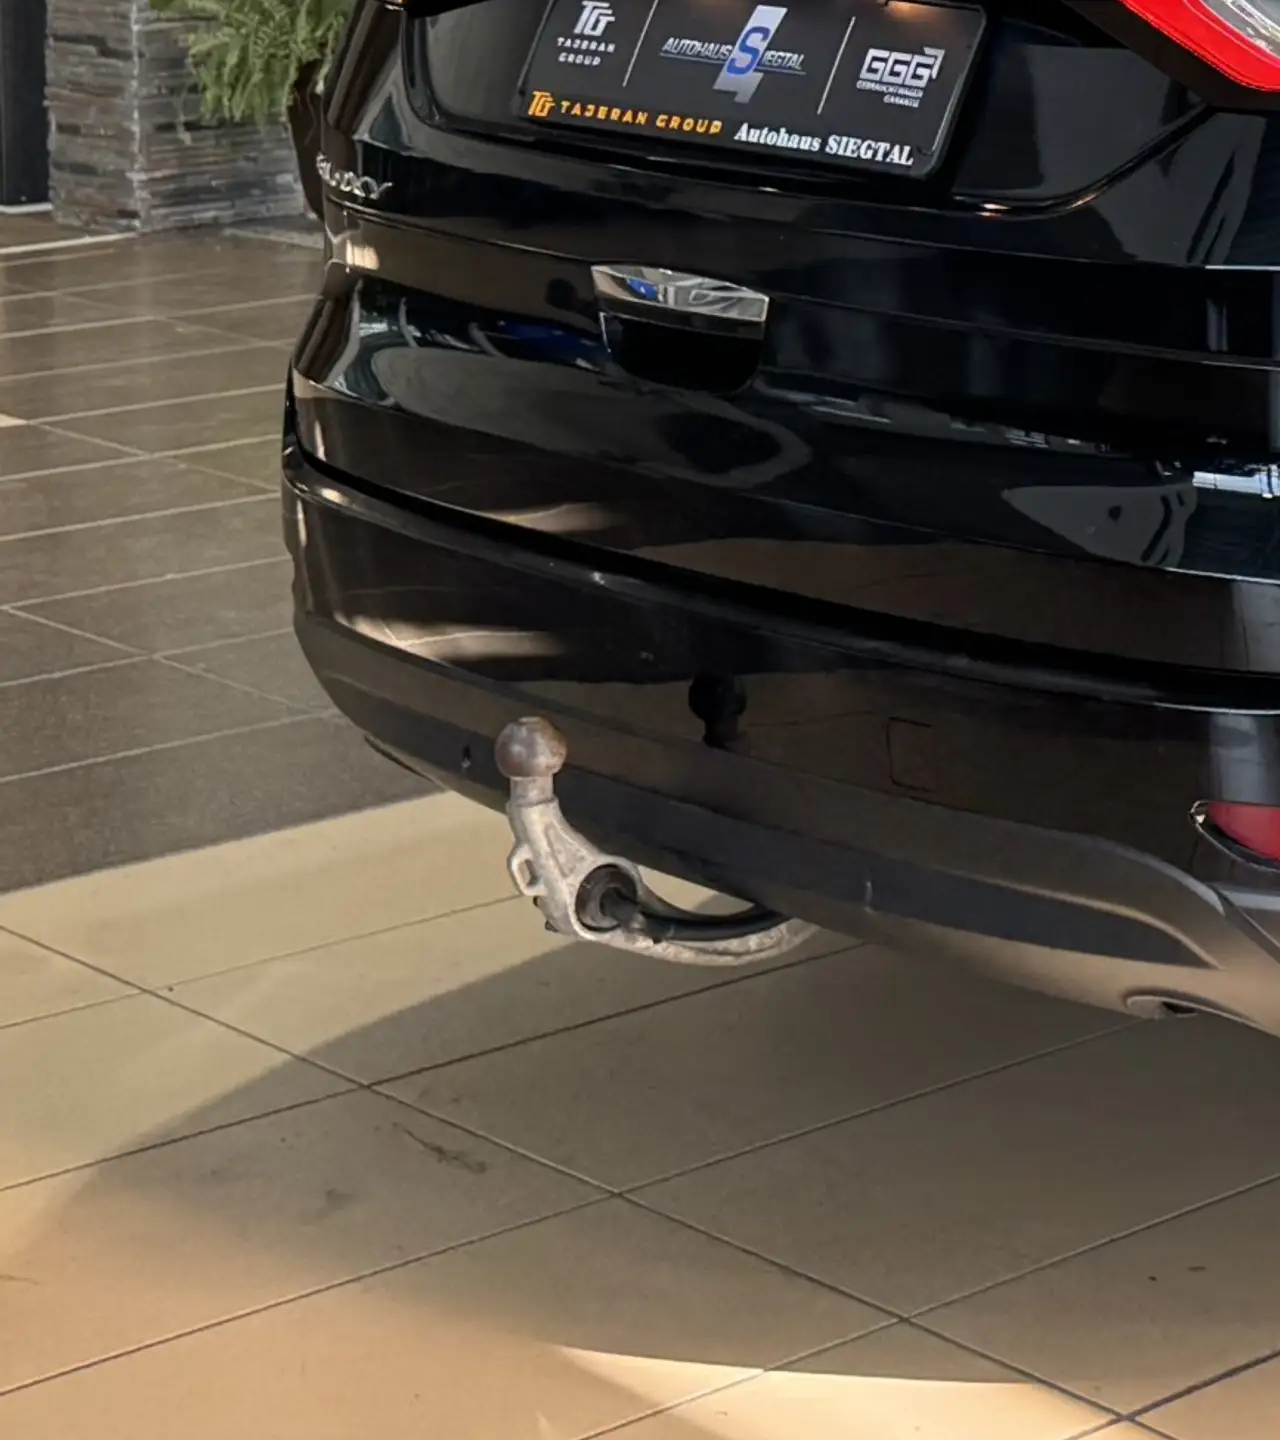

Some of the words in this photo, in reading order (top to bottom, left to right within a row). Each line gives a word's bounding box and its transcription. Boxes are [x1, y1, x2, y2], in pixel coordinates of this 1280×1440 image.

[557, 51, 602, 66] GROUP
[661, 36, 734, 61] AUTOHAUS
[560, 100, 649, 126] TAJERAN
[655, 114, 723, 135] GROUP
[734, 121, 822, 153] Autohaus
[824, 133, 914, 167] SIEGTAL
